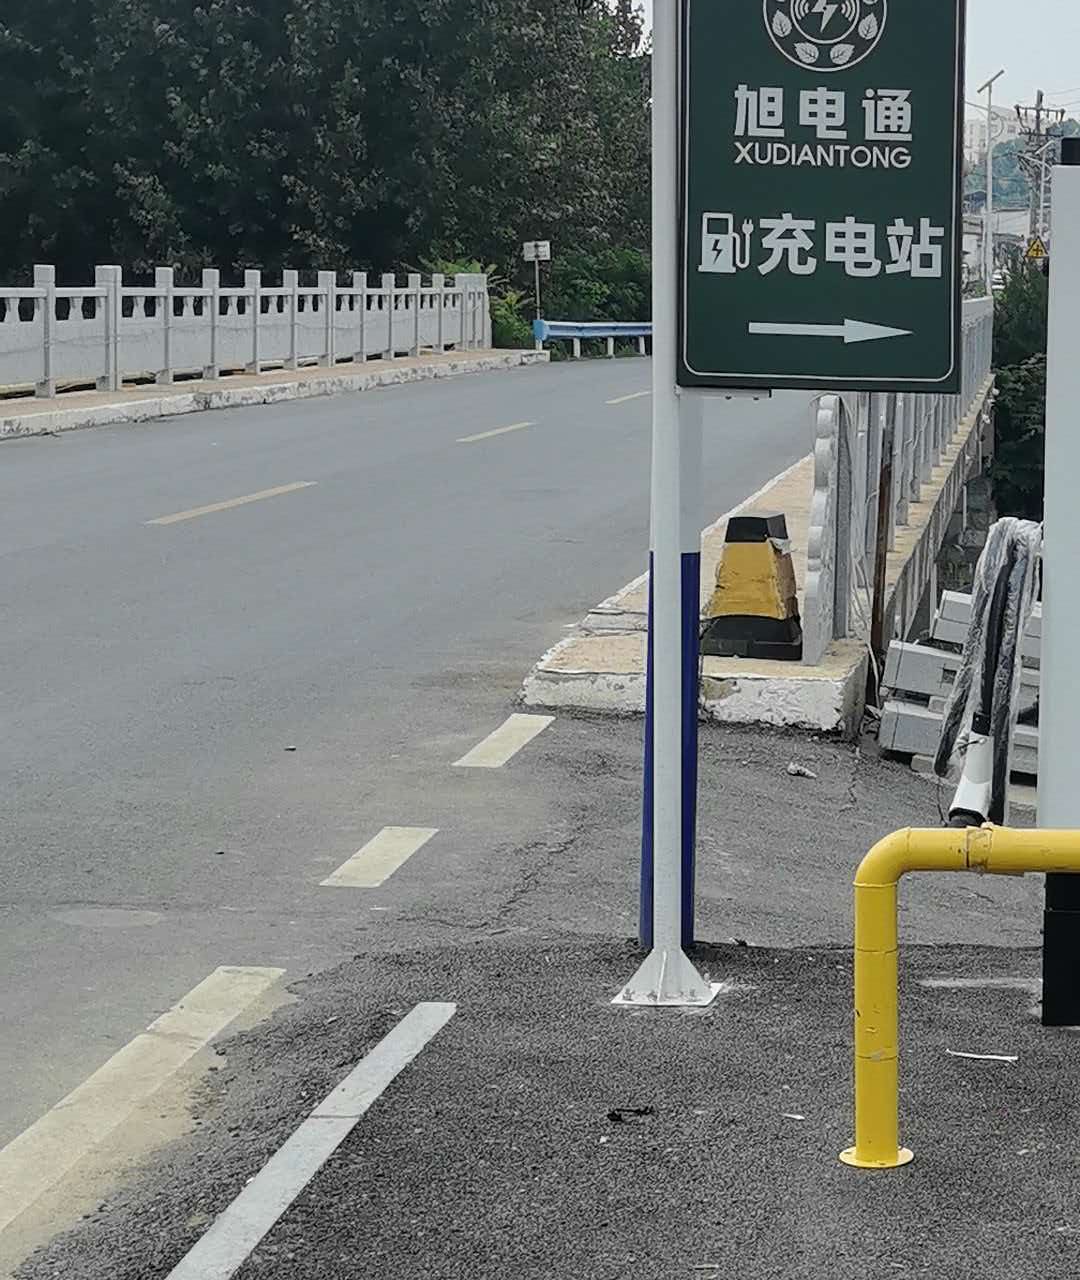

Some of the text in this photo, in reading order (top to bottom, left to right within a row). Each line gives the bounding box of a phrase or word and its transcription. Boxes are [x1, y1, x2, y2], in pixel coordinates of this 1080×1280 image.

[733, 84, 913, 142] 旭电通
[733, 141, 911, 169] XUDIANTONG
[757, 212, 944, 278] 充电站
